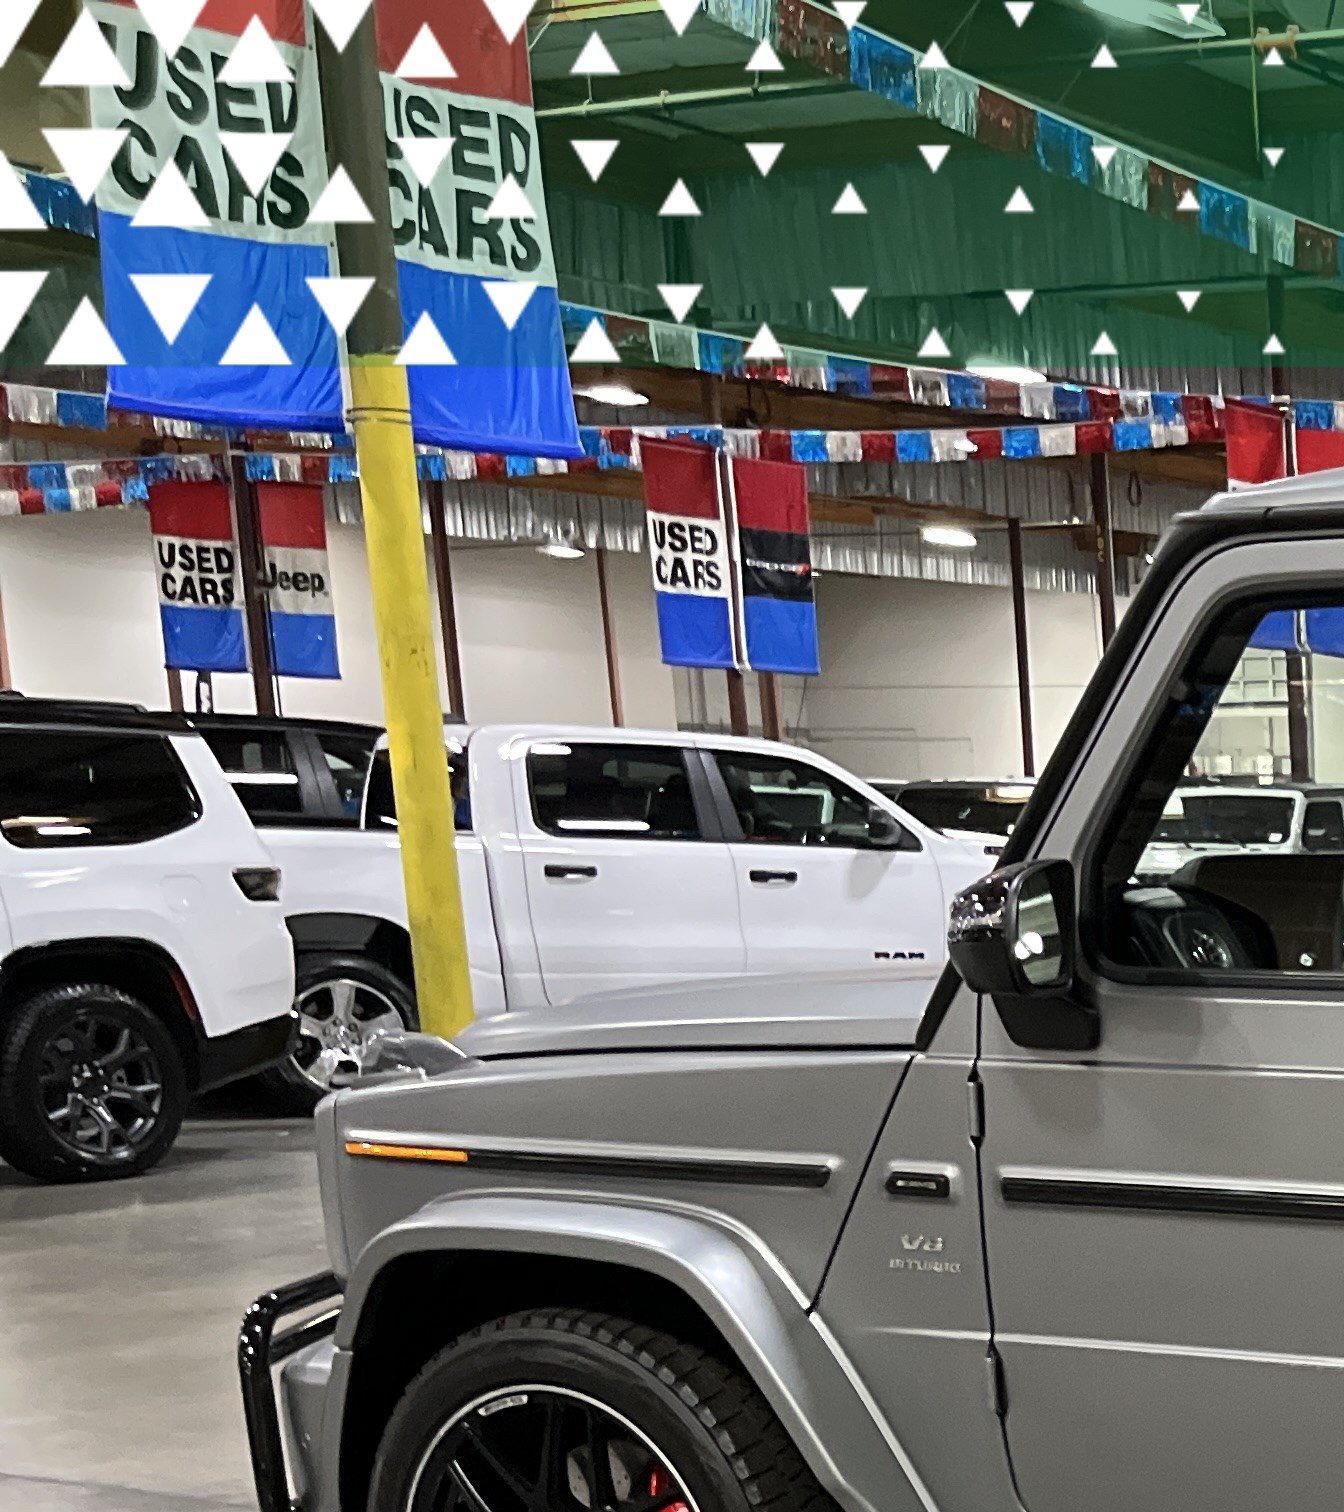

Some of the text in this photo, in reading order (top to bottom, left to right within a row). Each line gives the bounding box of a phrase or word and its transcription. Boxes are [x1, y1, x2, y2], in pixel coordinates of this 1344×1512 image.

[652, 519, 718, 556] USED
[158, 541, 235, 574] USED
[656, 554, 722, 590] CARS
[161, 572, 235, 605] CARS
[258, 561, 326, 598] Jeep
